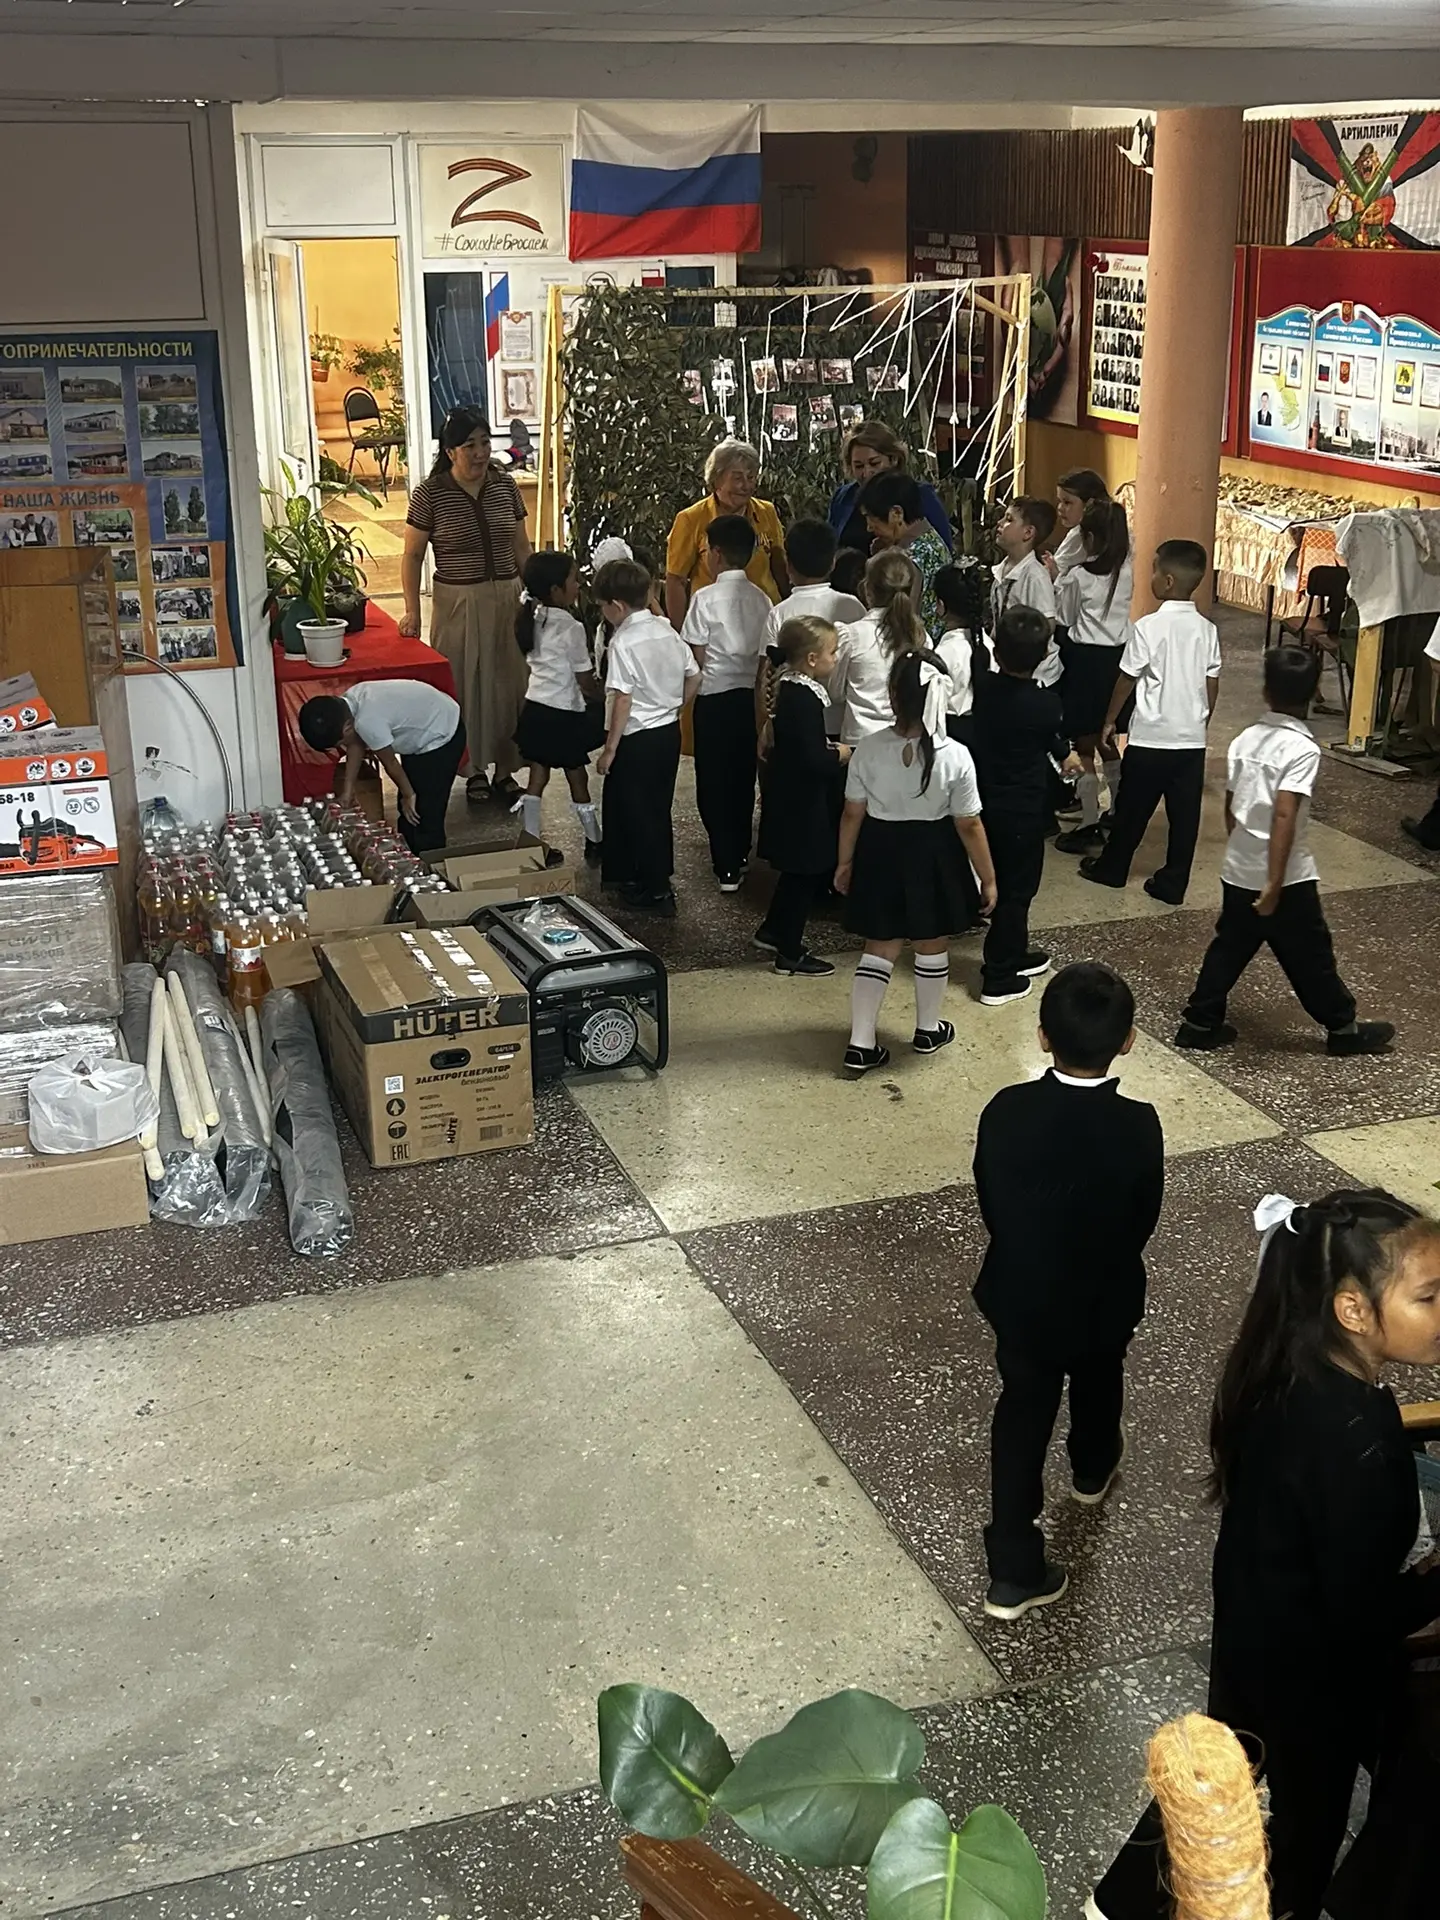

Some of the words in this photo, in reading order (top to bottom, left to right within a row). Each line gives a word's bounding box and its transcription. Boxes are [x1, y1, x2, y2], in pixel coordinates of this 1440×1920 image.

[1341, 123, 1398, 140] АРТИЛЛЕРИЯ
[447, 158, 544, 234] Z
[3, 493, 55, 508] НАША
[60, 490, 120, 506] ЖИЗНЬ
[0, 792, 35, 804] 58-18
[393, 1007, 499, 1038] HÜTER
[415, 1064, 511, 1085] ЭЛЕКТРОГЕНЕРАТОР
